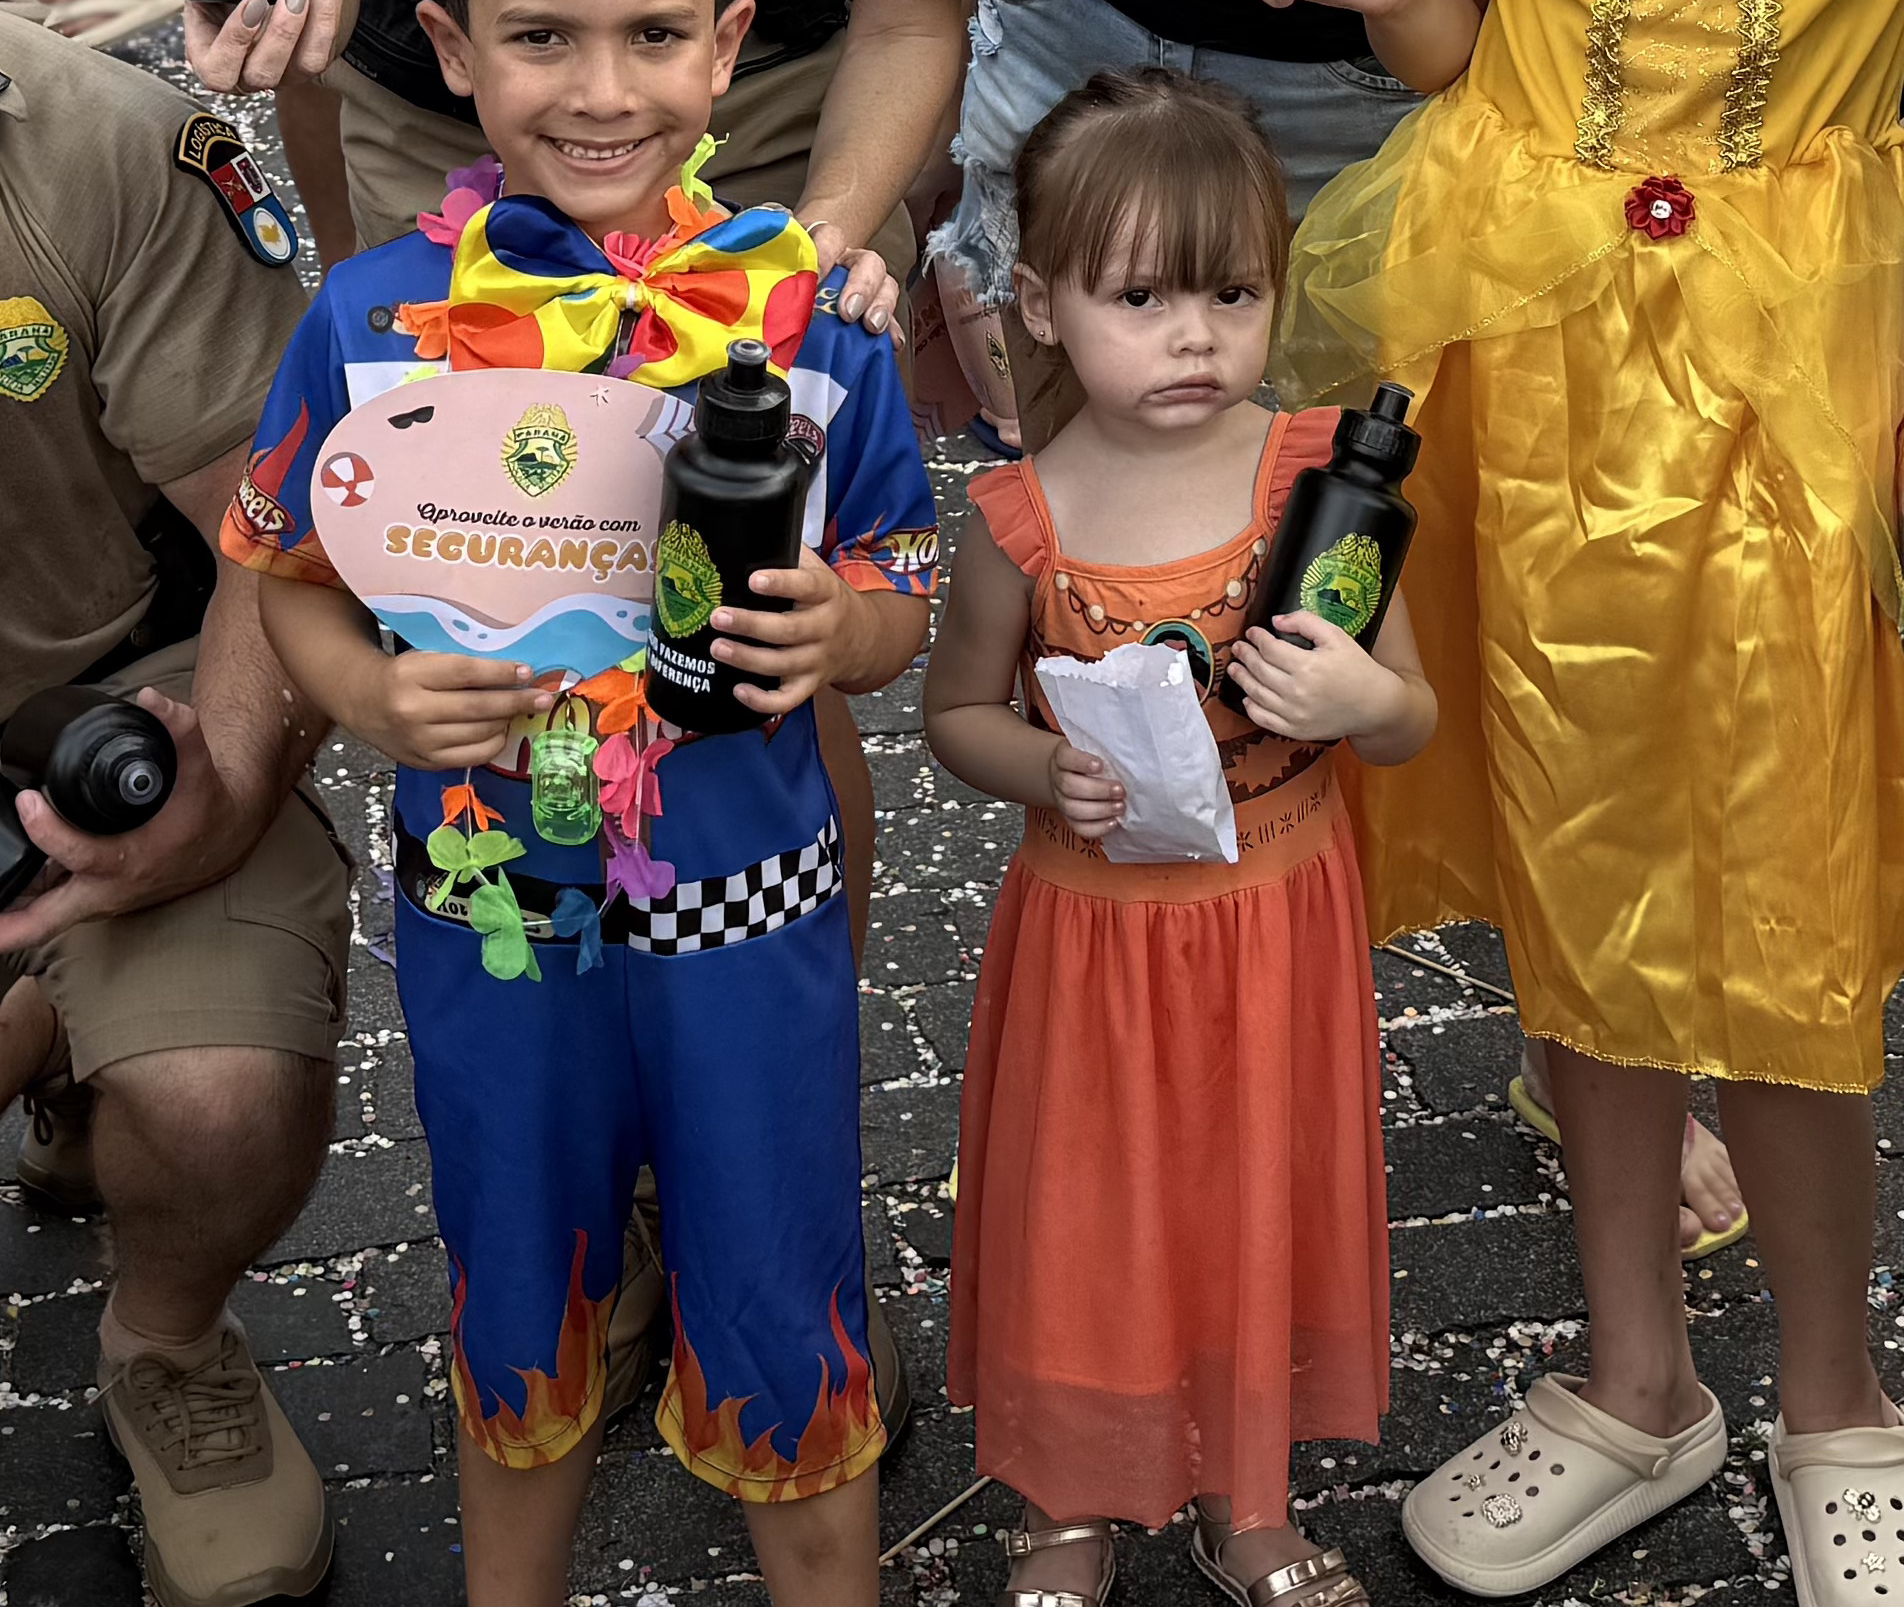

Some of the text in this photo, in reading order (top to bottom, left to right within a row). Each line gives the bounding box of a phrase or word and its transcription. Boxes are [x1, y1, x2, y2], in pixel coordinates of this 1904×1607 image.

[189, 121, 237, 160] LOGÍSTICA
[416, 502, 642, 533] Aproveite o verão com
[659, 642, 716, 676] FAZEMOS
